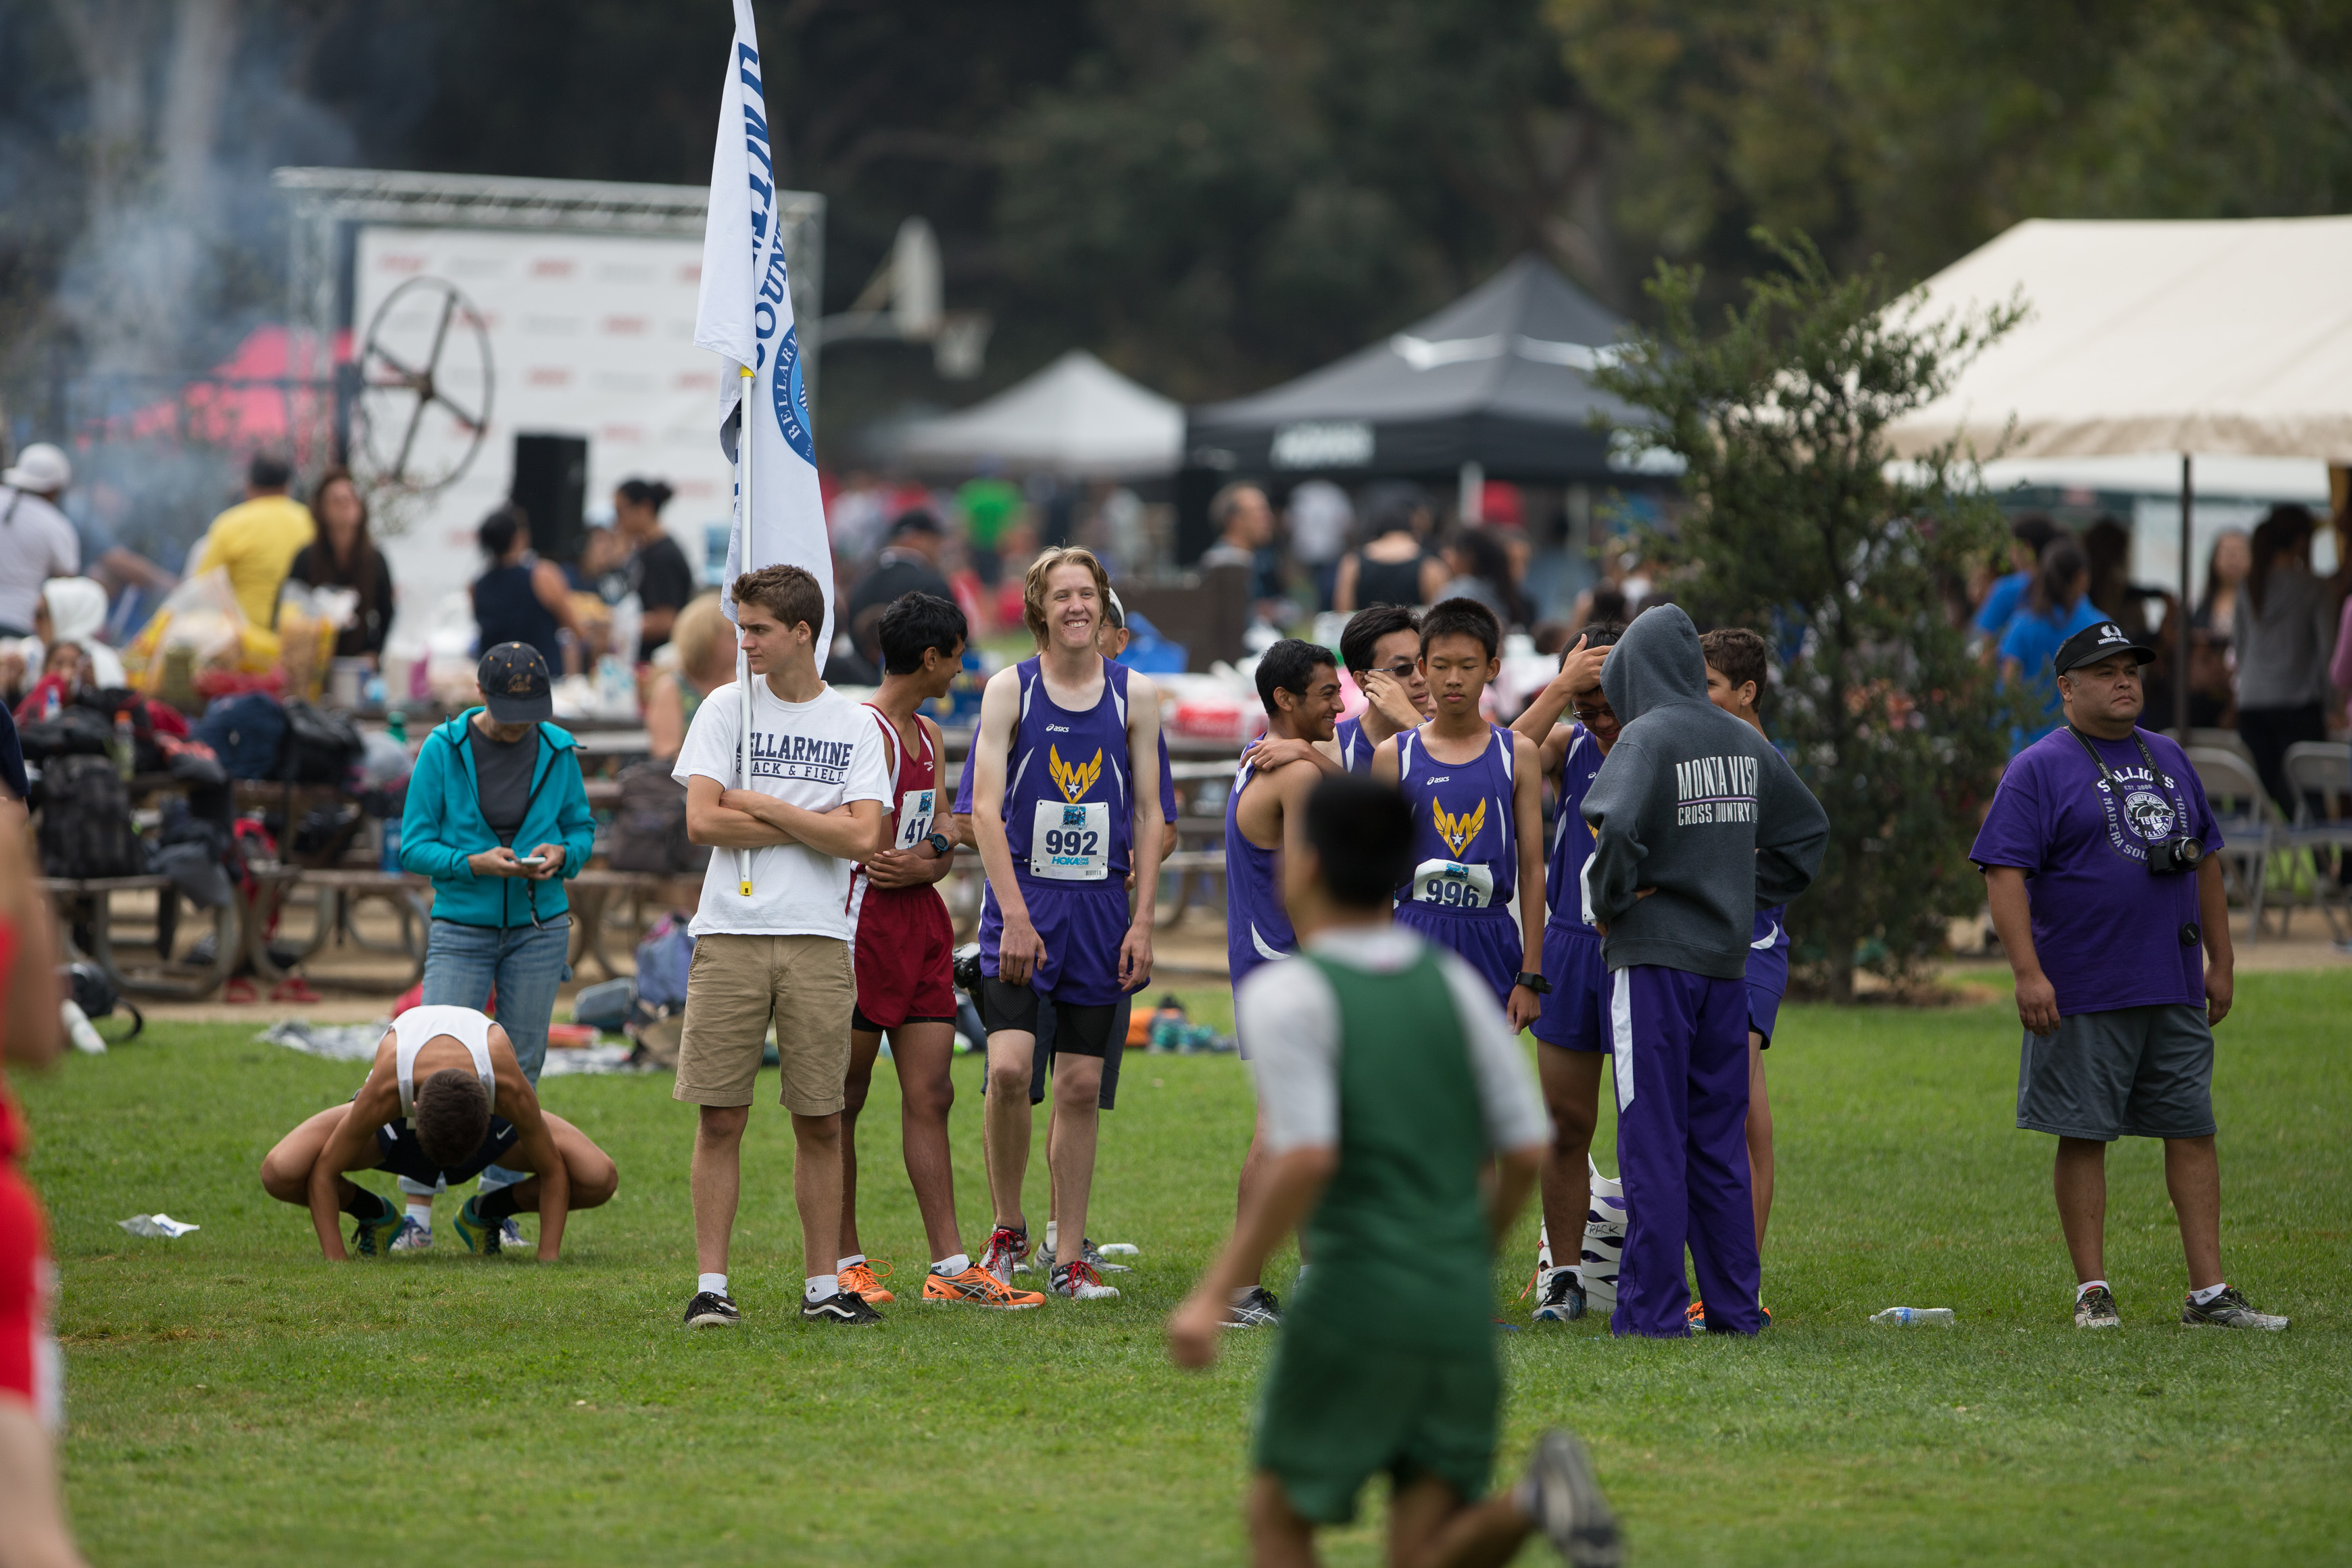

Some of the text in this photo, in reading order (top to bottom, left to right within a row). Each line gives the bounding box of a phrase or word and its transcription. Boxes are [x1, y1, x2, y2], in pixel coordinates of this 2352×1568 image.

[788, 765, 796, 776] &
[805, 766, 843, 782] FIELD
[1676, 756, 1728, 801] MONTA
[2097, 766, 2175, 793] SALLIOS
[2099, 762, 2113, 780] Nikon
[1678, 803, 1713, 826] CROSS
[2103, 798, 2124, 848] MADERA
[2175, 795, 2188, 833] HOOL
[1046, 829, 1098, 856] 992
[2134, 822, 2170, 837] SLLIONS
[1052, 856, 1079, 866] HOKA
[1426, 879, 1480, 908] 996
